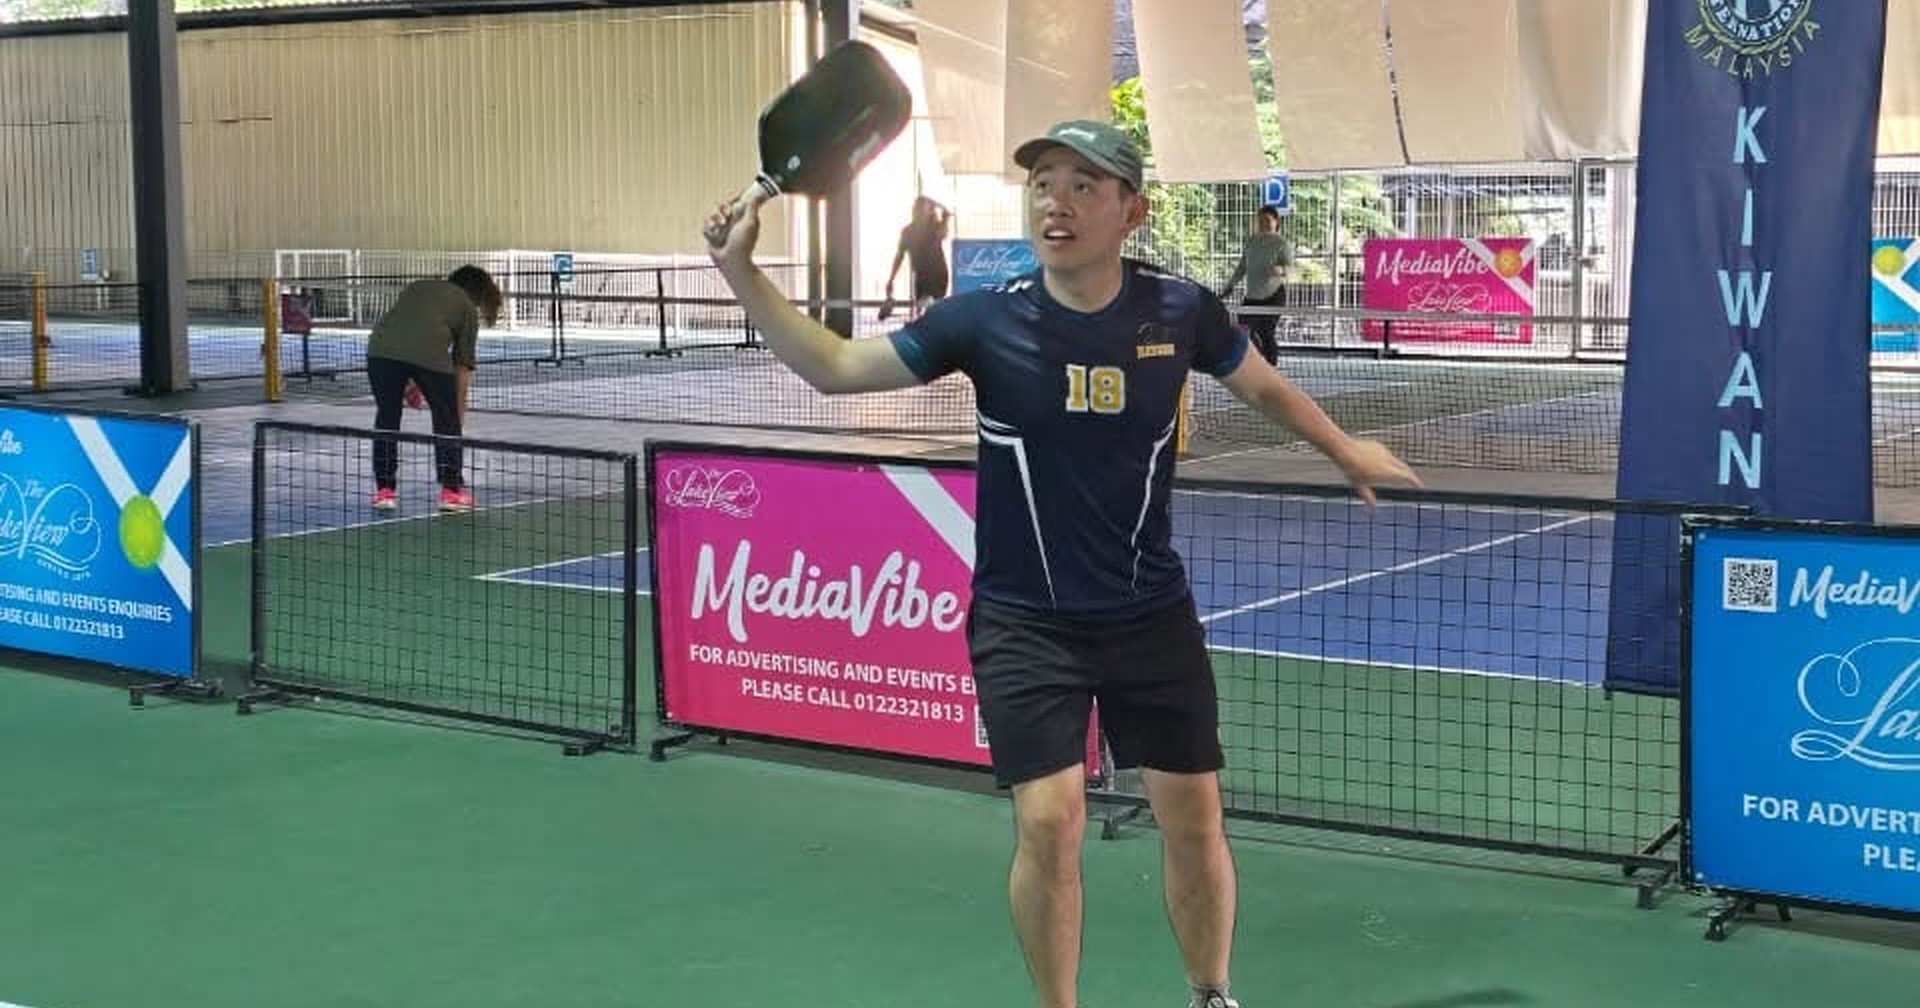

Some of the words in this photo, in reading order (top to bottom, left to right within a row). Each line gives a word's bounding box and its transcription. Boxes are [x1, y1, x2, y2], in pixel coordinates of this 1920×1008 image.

[1684, 20, 1821, 78] MALAYSIA
[1265, 179, 1285, 205] D
[1376, 247, 1488, 286] MediaVibe
[1065, 363, 1126, 414] 18
[36, 589, 60, 606] AND
[62, 592, 107, 613] EVENTS
[108, 599, 172, 623] ENQUIRIES
[691, 540, 964, 643] MediaVibe
[24, 611, 52, 629] CALL
[690, 644, 723, 665] FOR
[726, 649, 839, 679] ADVERTISING
[844, 663, 883, 684] AND
[888, 667, 957, 693] EVENTS
[742, 678, 803, 704] PLEASE
[807, 686, 851, 710] CALL
[854, 693, 964, 723] 0122321813
[1743, 793, 1800, 822] FOR
[1863, 842, 1920, 874] PLE
